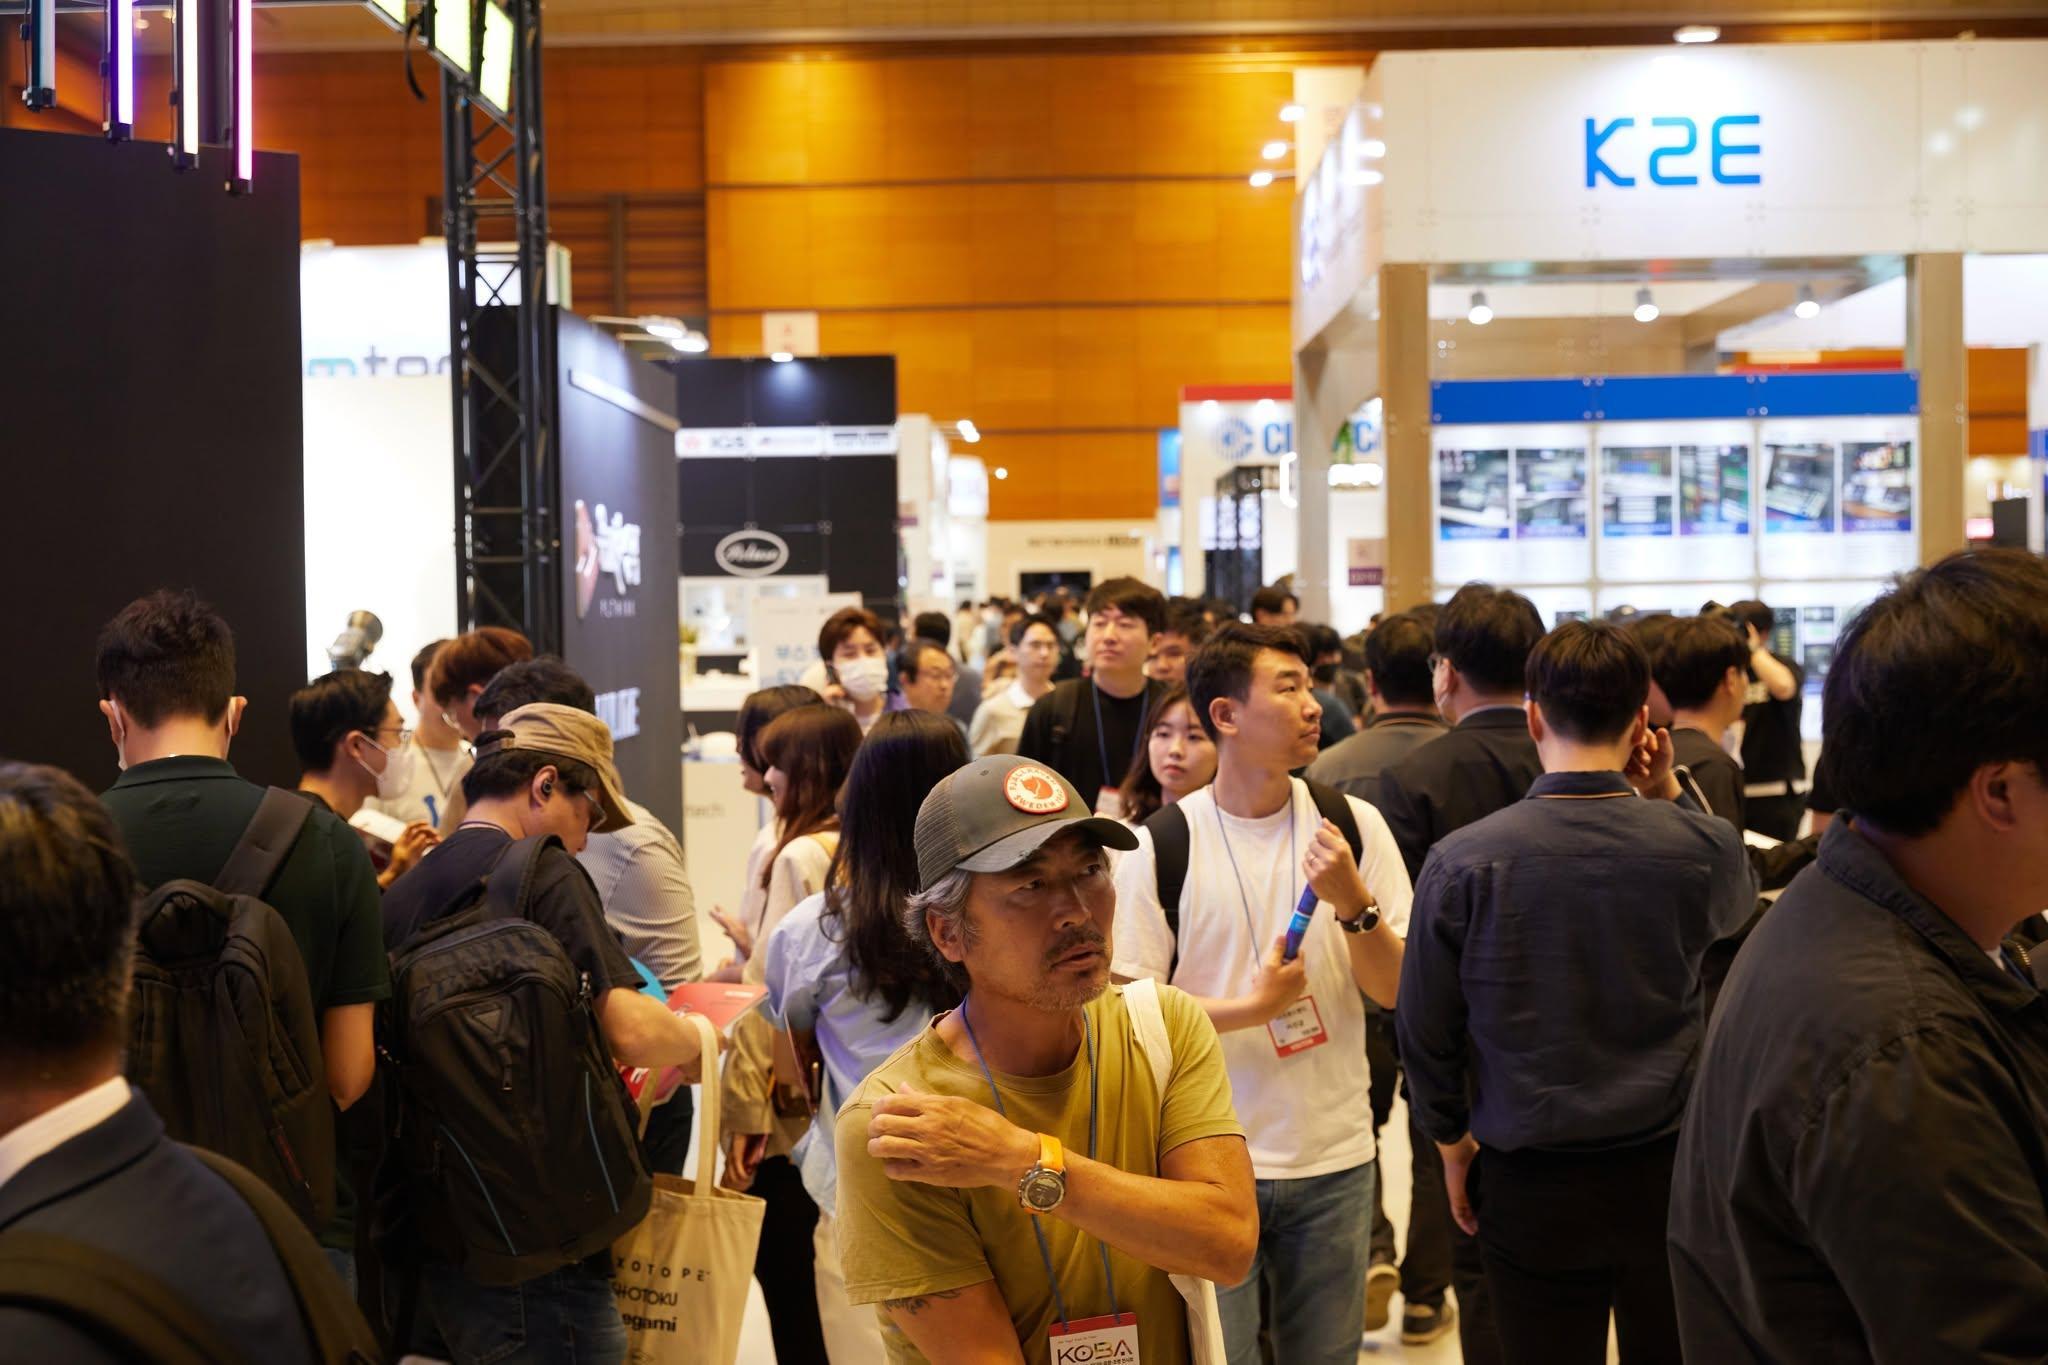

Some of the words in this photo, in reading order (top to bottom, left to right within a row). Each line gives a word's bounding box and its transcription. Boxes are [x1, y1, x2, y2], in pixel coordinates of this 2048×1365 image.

[1585, 115, 1761, 188] K2E
[1013, 794, 1057, 810] SWEDEN
[1057, 1339, 1133, 1365] KOBA
